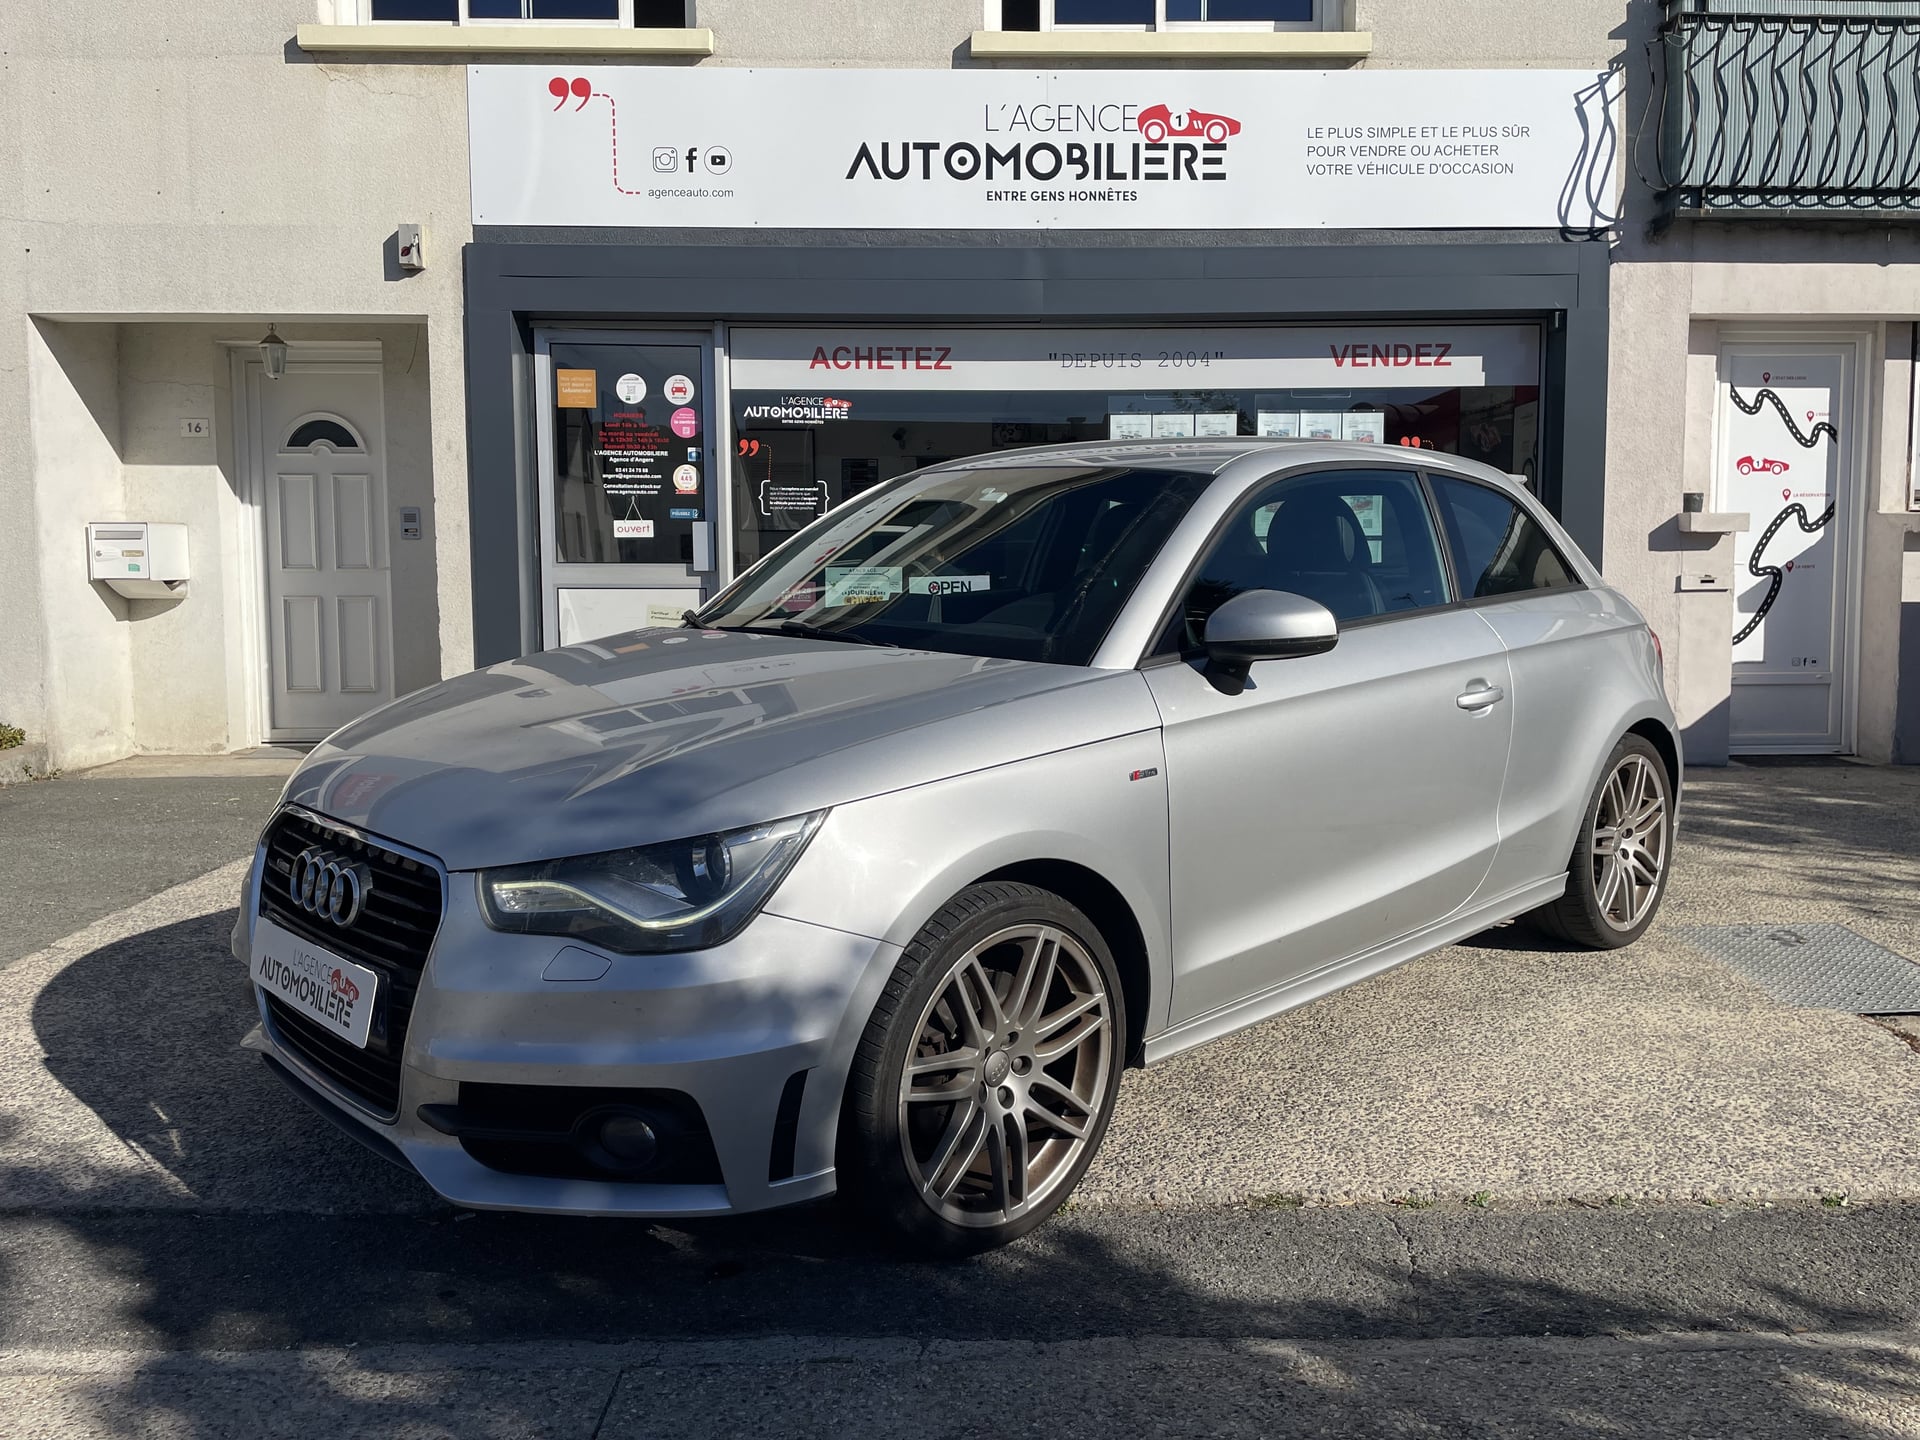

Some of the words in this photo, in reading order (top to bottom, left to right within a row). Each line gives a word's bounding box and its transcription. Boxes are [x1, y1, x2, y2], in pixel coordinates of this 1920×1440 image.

[985, 104, 1138, 132] L'AGENCE
[1175, 114, 1182, 127] 1
[1307, 127, 1323, 139] LE
[1327, 127, 1363, 139] PLUS
[1367, 127, 1417, 139] SIMPLE
[1421, 127, 1438, 138] ET
[1442, 126, 1458, 138] LE
[1462, 126, 1498, 138] PLUS
[1501, 124, 1530, 138] SÛR
[1307, 145, 1346, 157] POUR
[1350, 145, 1407, 157] VENDRE
[1410, 145, 1430, 156] OU
[1434, 144, 1499, 156] ACHETER
[845, 141, 1227, 181] AUTOMOBILIERE
[1306, 164, 1353, 175] VOTRE
[1356, 161, 1425, 175] VÉHICULE
[1429, 162, 1514, 175] D'OCCASION
[648, 187, 734, 199] agenceauto.com
[986, 190, 1027, 202] ENTRE
[1030, 190, 1065, 202] GENS
[1068, 187, 1138, 202] HONNÊTES
[809, 346, 952, 370] ACHETEZ
[1329, 343, 1452, 367] VENDEZ
[781, 396, 823, 406] L'AGENCE
[743, 406, 849, 419] AUTOMOBILIERE
[187, 422, 202, 433] 16
[617, 525, 650, 533] ouvert
[928, 580, 972, 595] OPEN
[259, 954, 354, 1029] AUTOMOBILIERE
